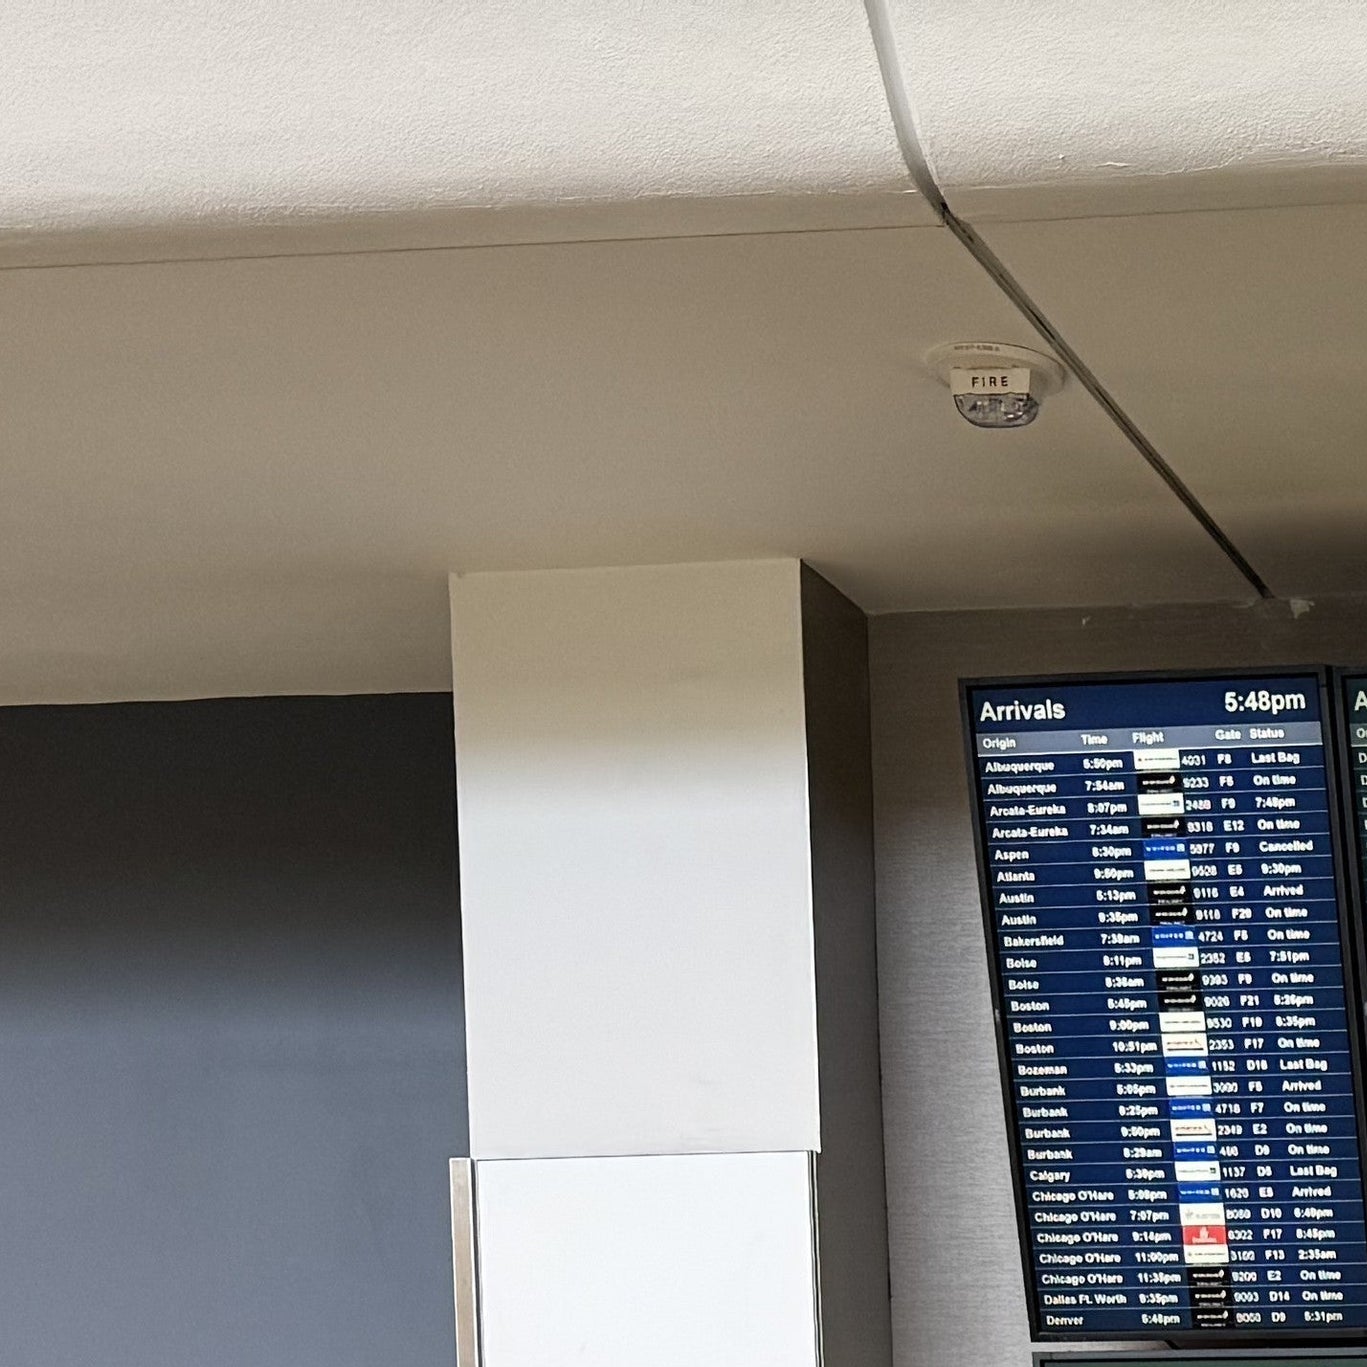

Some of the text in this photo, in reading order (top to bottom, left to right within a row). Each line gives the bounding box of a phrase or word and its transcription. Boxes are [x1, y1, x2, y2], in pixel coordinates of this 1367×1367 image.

[971, 376, 1009, 388] FIRE
[980, 690, 1305, 721] Arrivals 5:48pm
[982, 728, 1284, 750] Origin Time Flight Gate Status
[1253, 774, 1296, 785] On time
[994, 849, 1029, 862] Aspen
